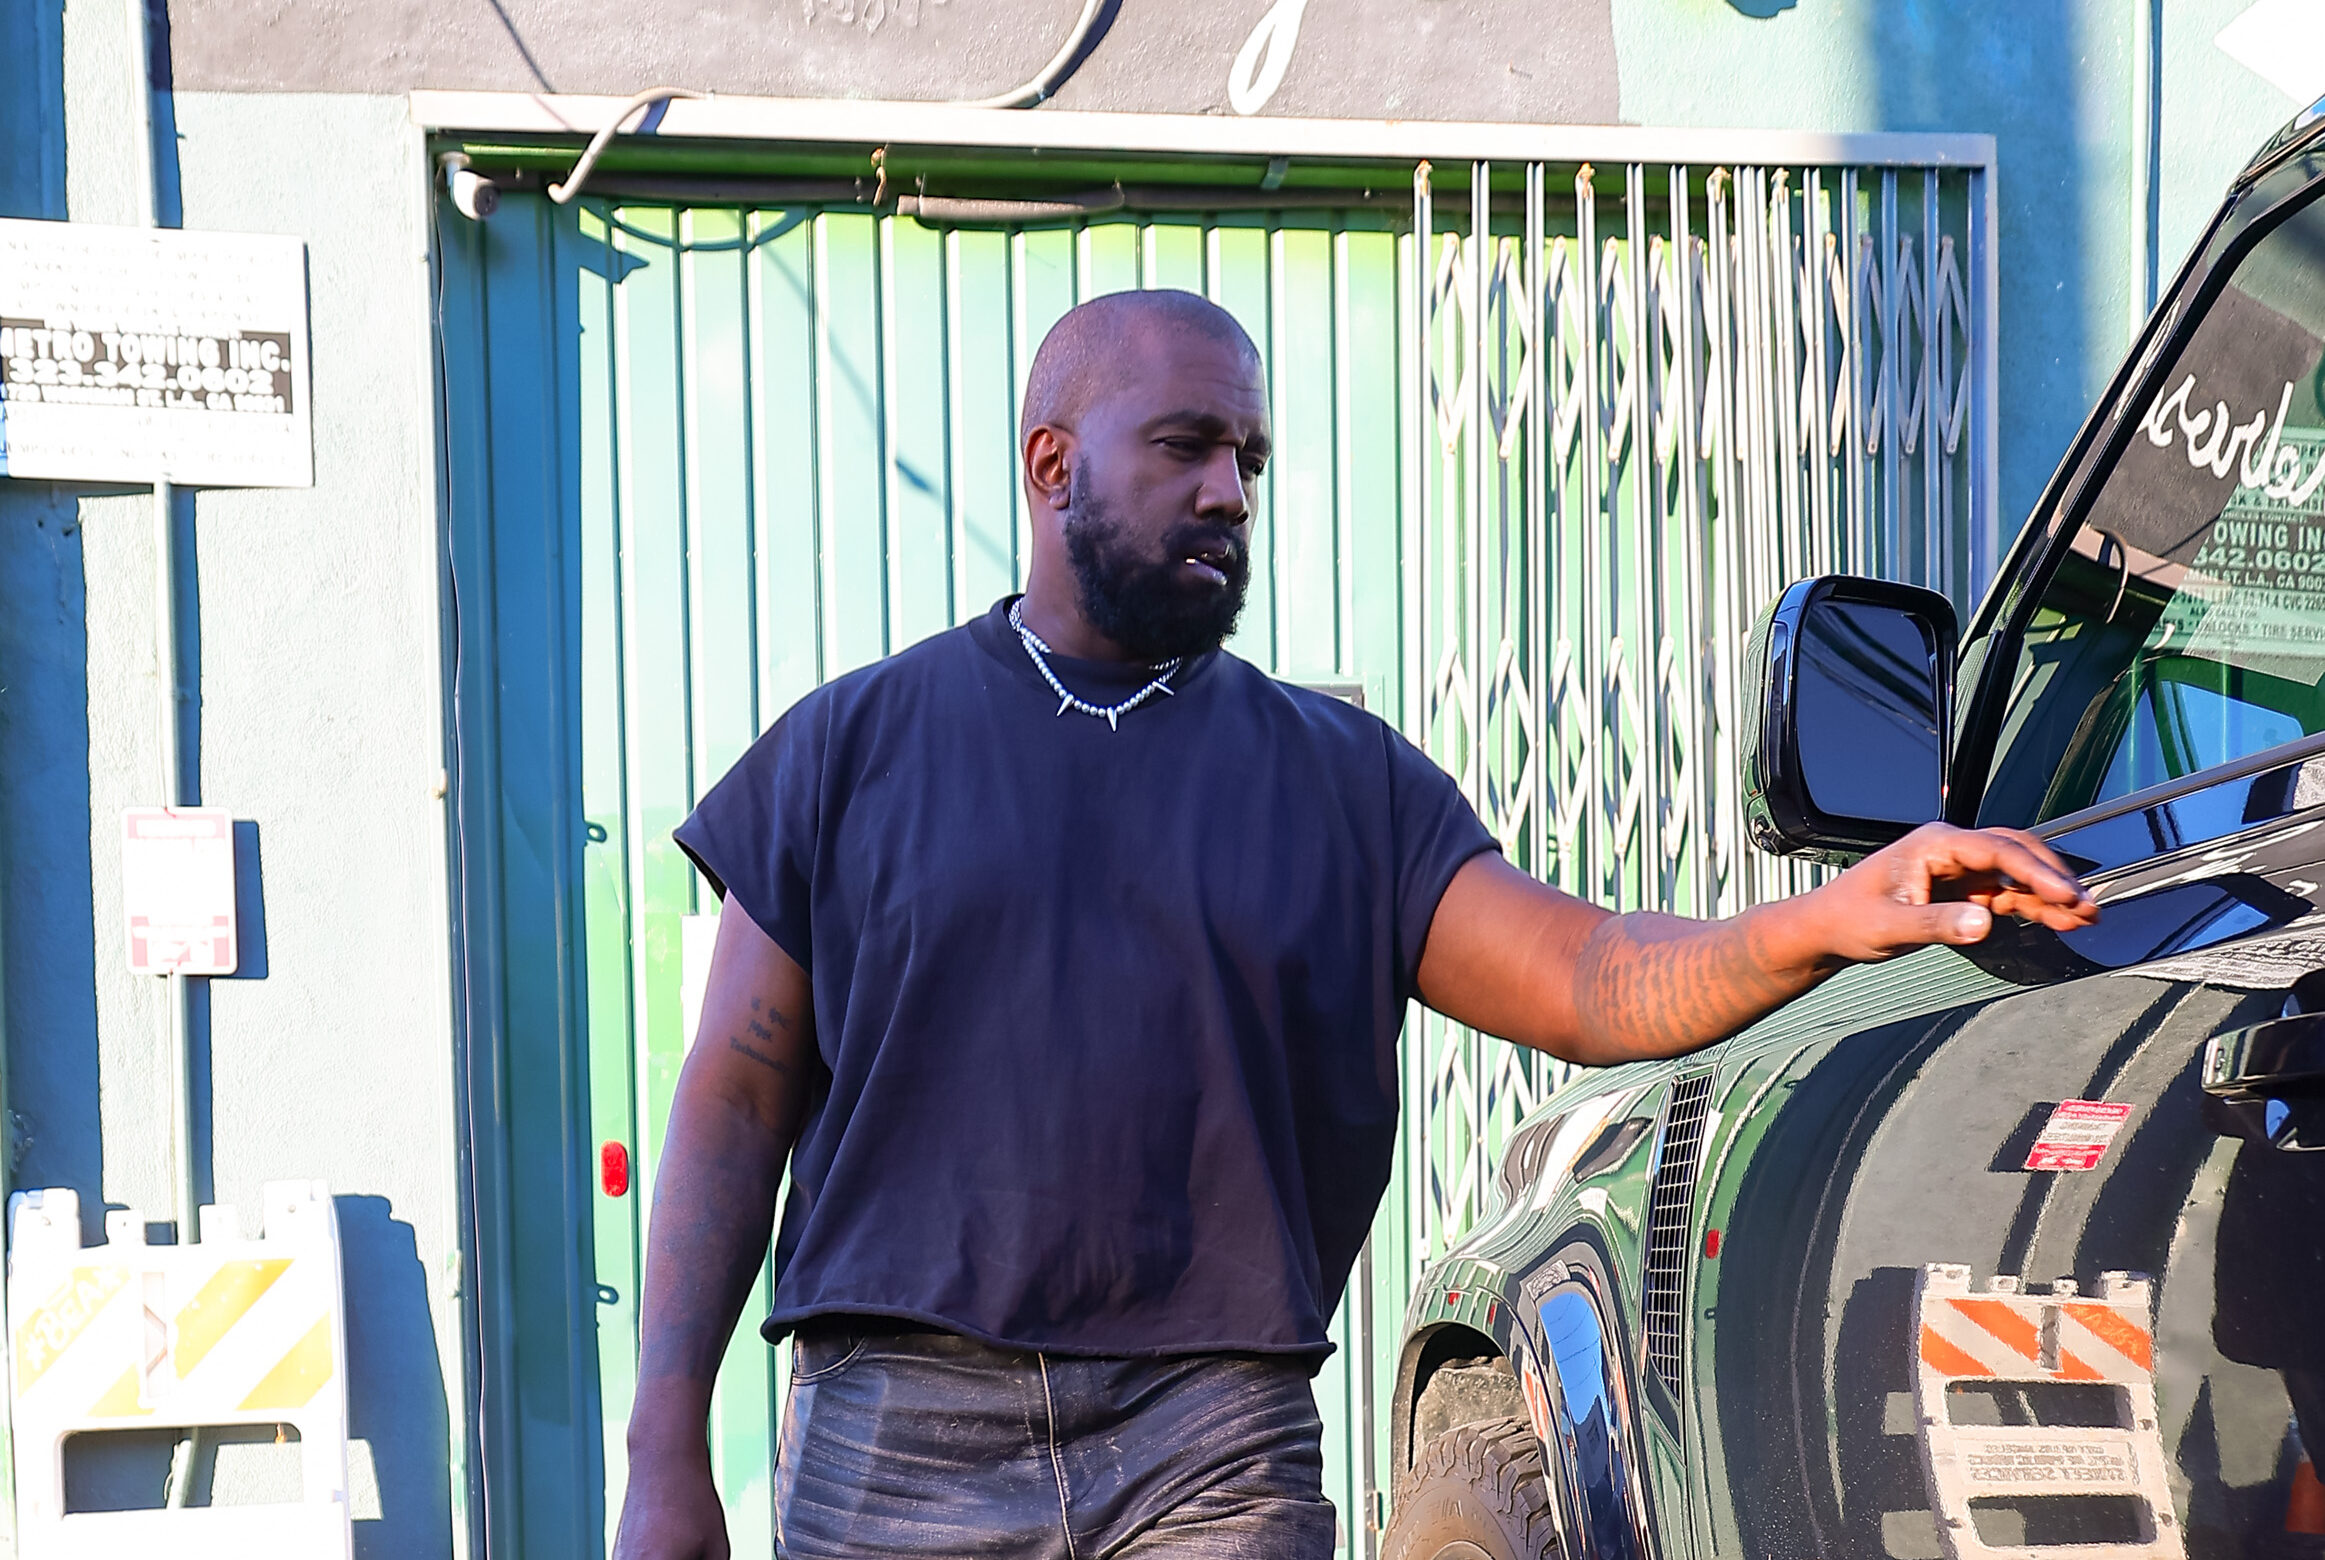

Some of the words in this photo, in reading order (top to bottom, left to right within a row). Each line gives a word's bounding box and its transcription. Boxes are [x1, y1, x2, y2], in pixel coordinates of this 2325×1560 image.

[101, 333, 221, 367] TOWING
[229, 340, 291, 372] INC.
[9, 358, 274, 395] 323.342.0602
[2206, 521, 2289, 547] OWING
[2299, 526, 2325, 551] IN
[2276, 575, 2296, 589] CA
